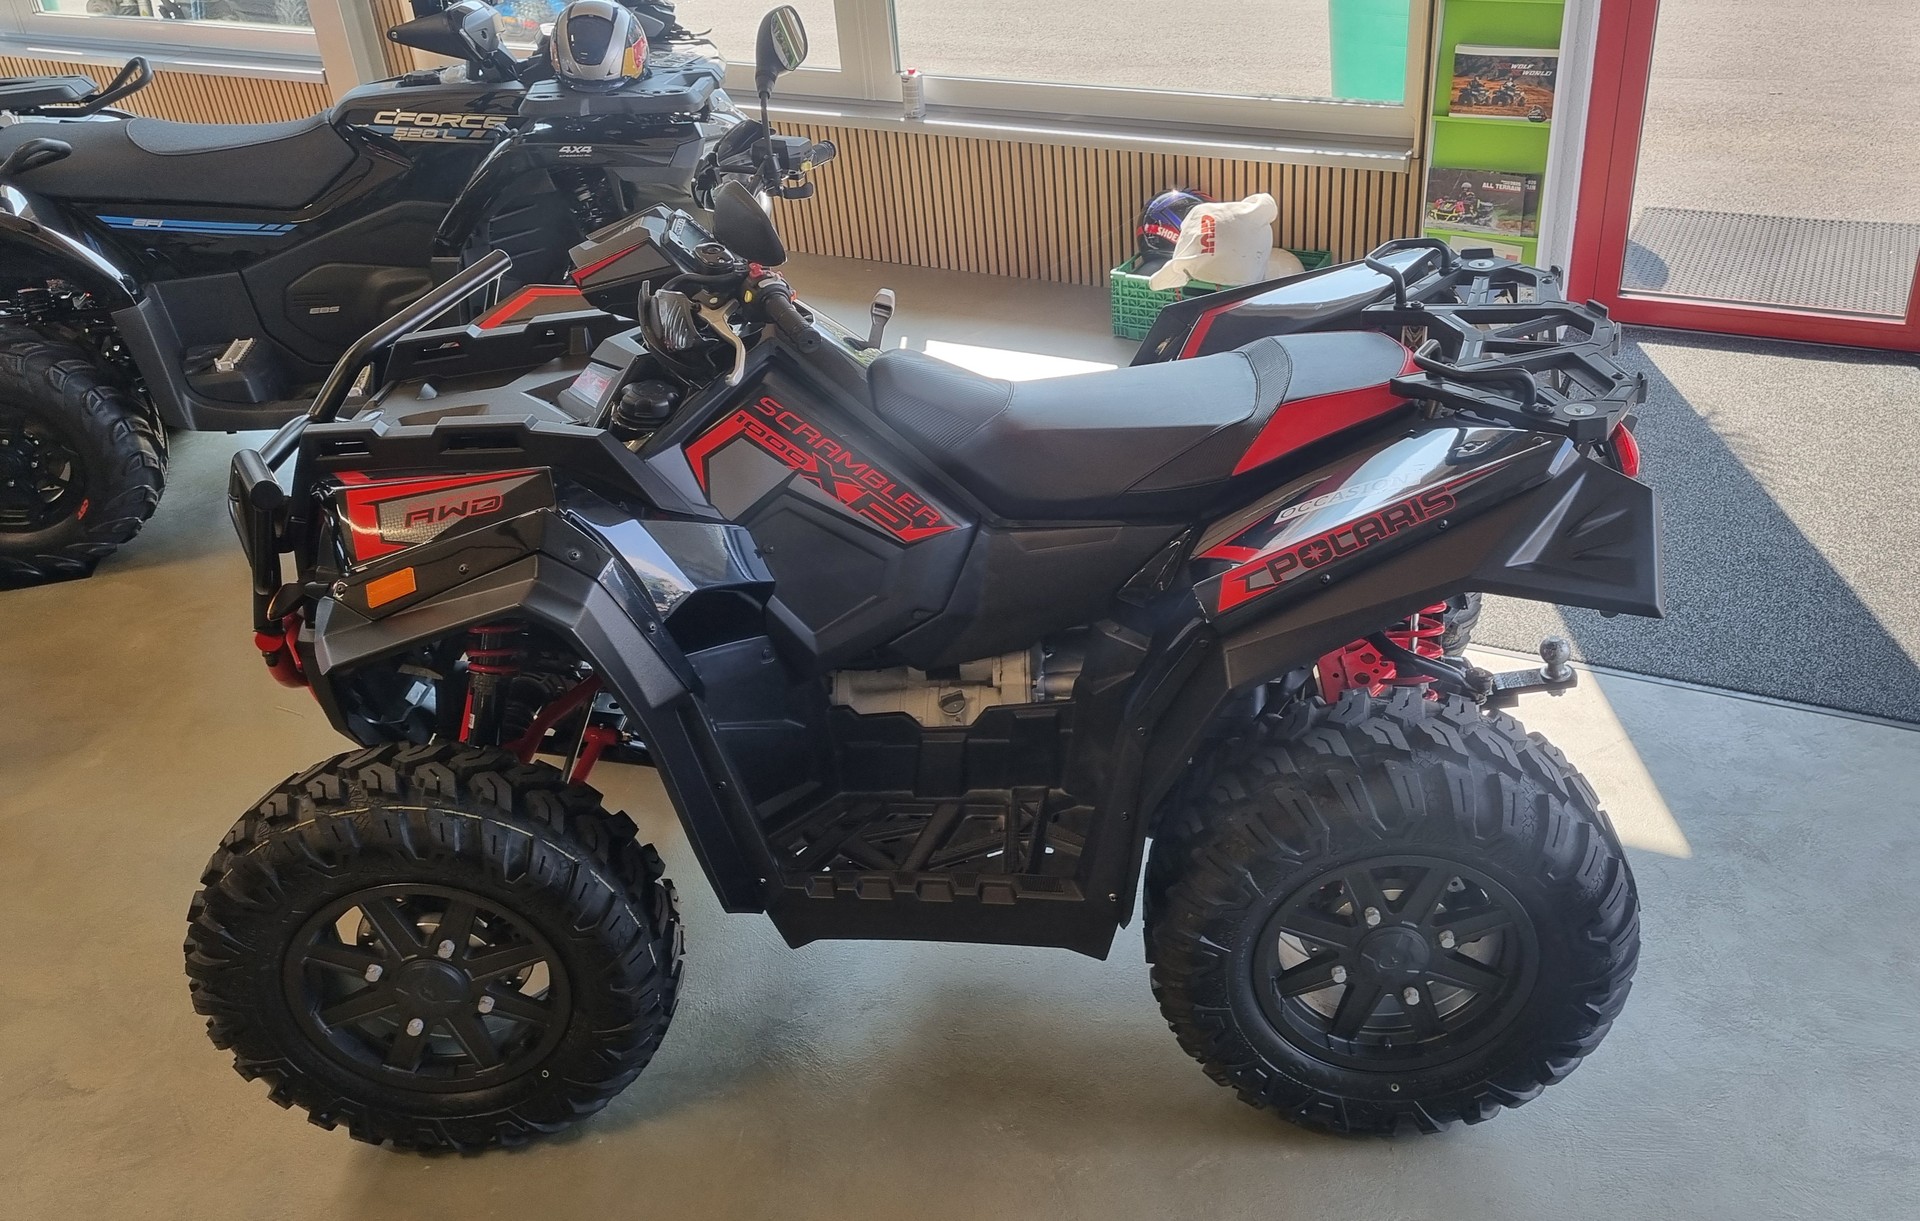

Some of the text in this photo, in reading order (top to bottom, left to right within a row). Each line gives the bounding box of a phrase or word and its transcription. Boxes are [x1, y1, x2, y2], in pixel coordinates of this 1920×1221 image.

[374, 111, 508, 129] CFORCE
[1495, 183, 1521, 192] TERRAIN
[132, 218, 163, 228] EFI
[736, 414, 913, 533] 1000 XP
[753, 397, 941, 527] SCRAMBLER
[404, 495, 504, 528] AWD
[1280, 474, 1409, 519] OCCASION
[1266, 486, 1456, 584] POLARIS
